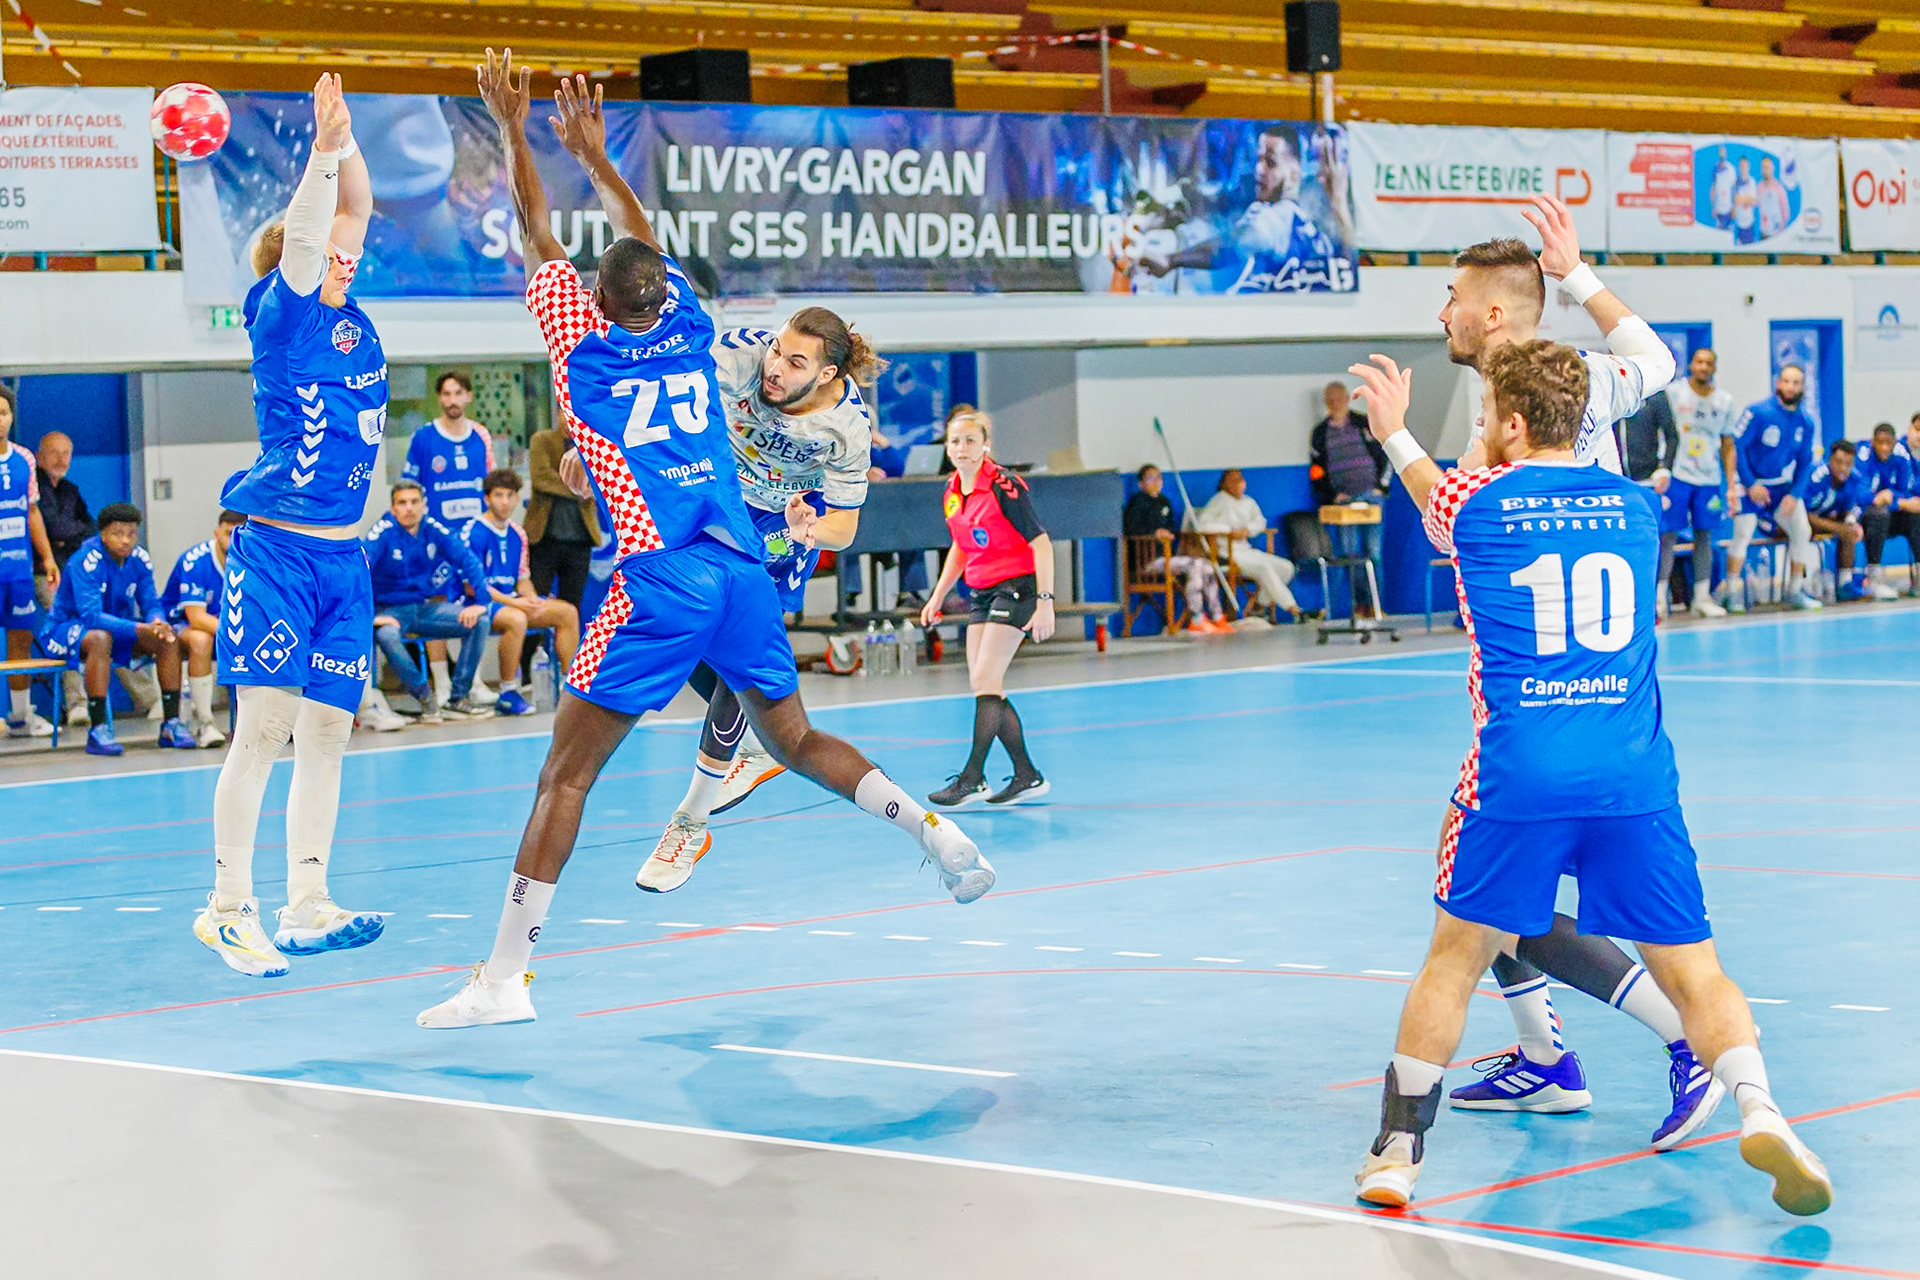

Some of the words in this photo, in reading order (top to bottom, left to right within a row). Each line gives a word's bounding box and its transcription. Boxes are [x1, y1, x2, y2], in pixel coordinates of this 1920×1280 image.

[35, 114, 53, 127] DE
[60, 156, 139, 169] TERRASSES
[666, 145, 986, 196] LIVRY-GARGAN
[1375, 163, 1431, 190] JEAN
[1437, 164, 1544, 193] LEFEBVRE
[729, 210, 808, 259] SES
[821, 211, 1146, 259] HANDBALLEURS
[611, 369, 710, 449] 25
[1499, 494, 1625, 511] EFFOR
[1509, 551, 1636, 656] 10
[311, 652, 357, 678] Rezé
[1521, 674, 1629, 698] Campanile
